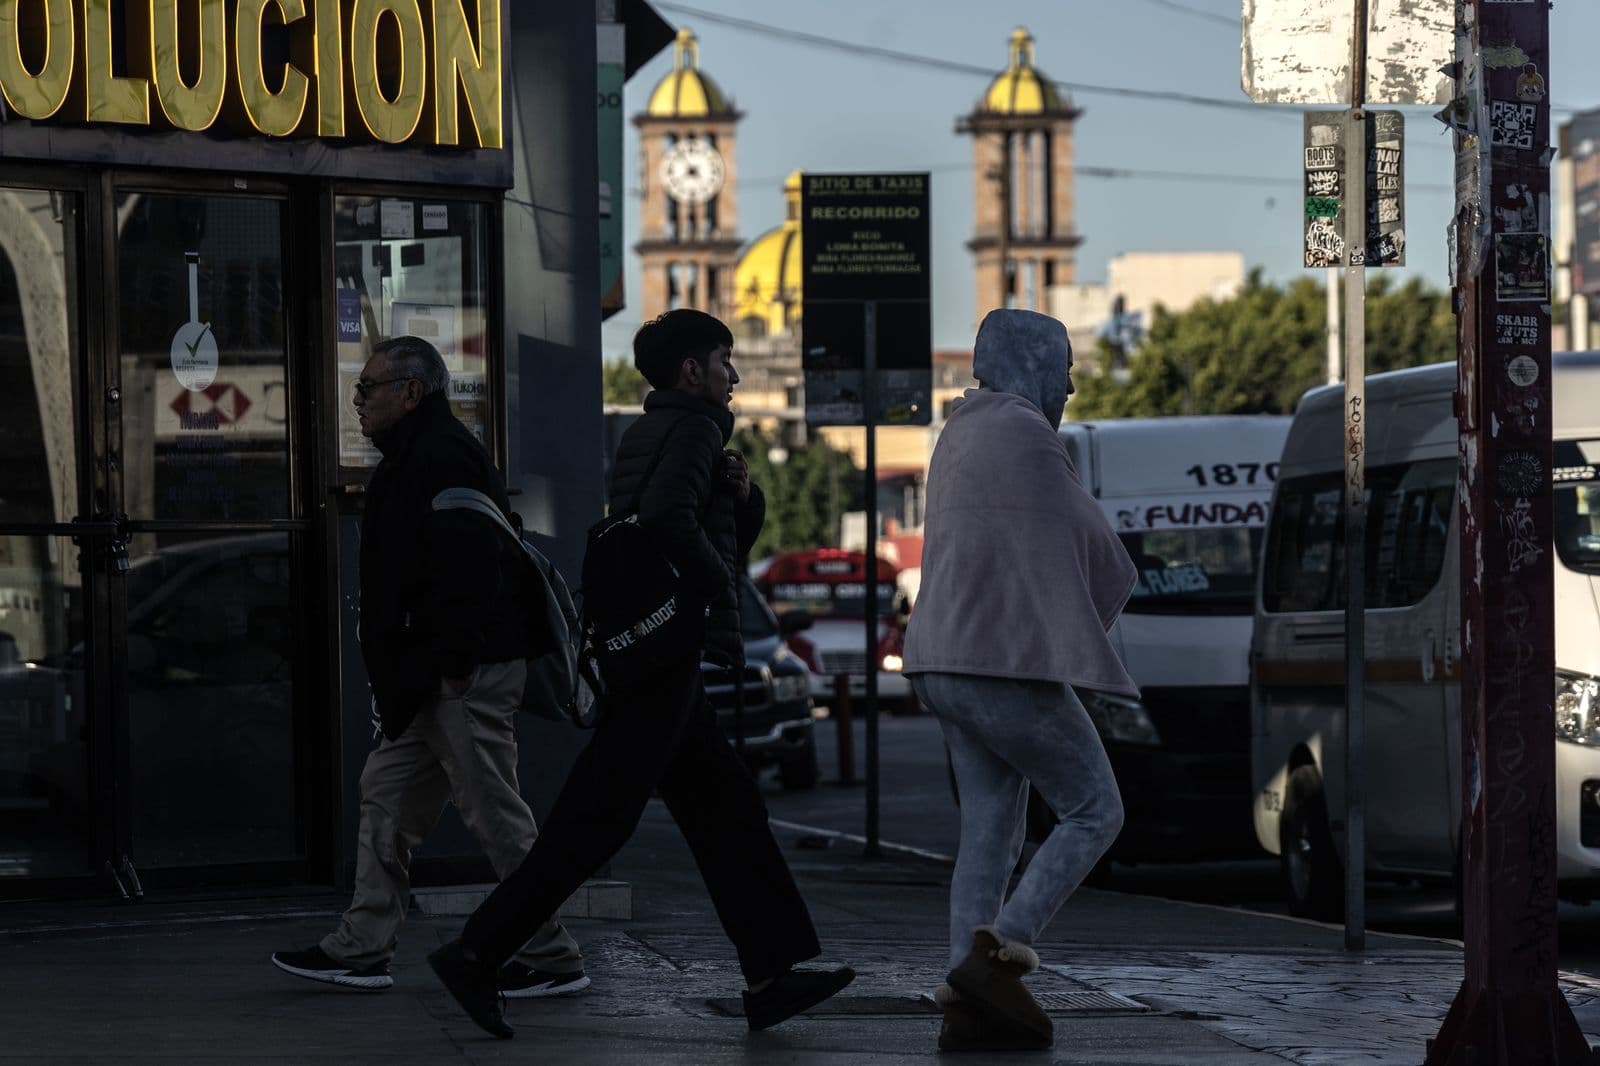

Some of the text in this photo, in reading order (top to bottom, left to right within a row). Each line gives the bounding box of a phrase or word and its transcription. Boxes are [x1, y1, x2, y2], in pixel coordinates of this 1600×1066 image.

[1307, 147, 1335, 160] ROOTS
[810, 176, 923, 189] SITIO DE TAXIS
[812, 205, 920, 219] RECORRIDO
[340, 321, 360, 333] VISA
[1146, 501, 1268, 527] FUNDA
